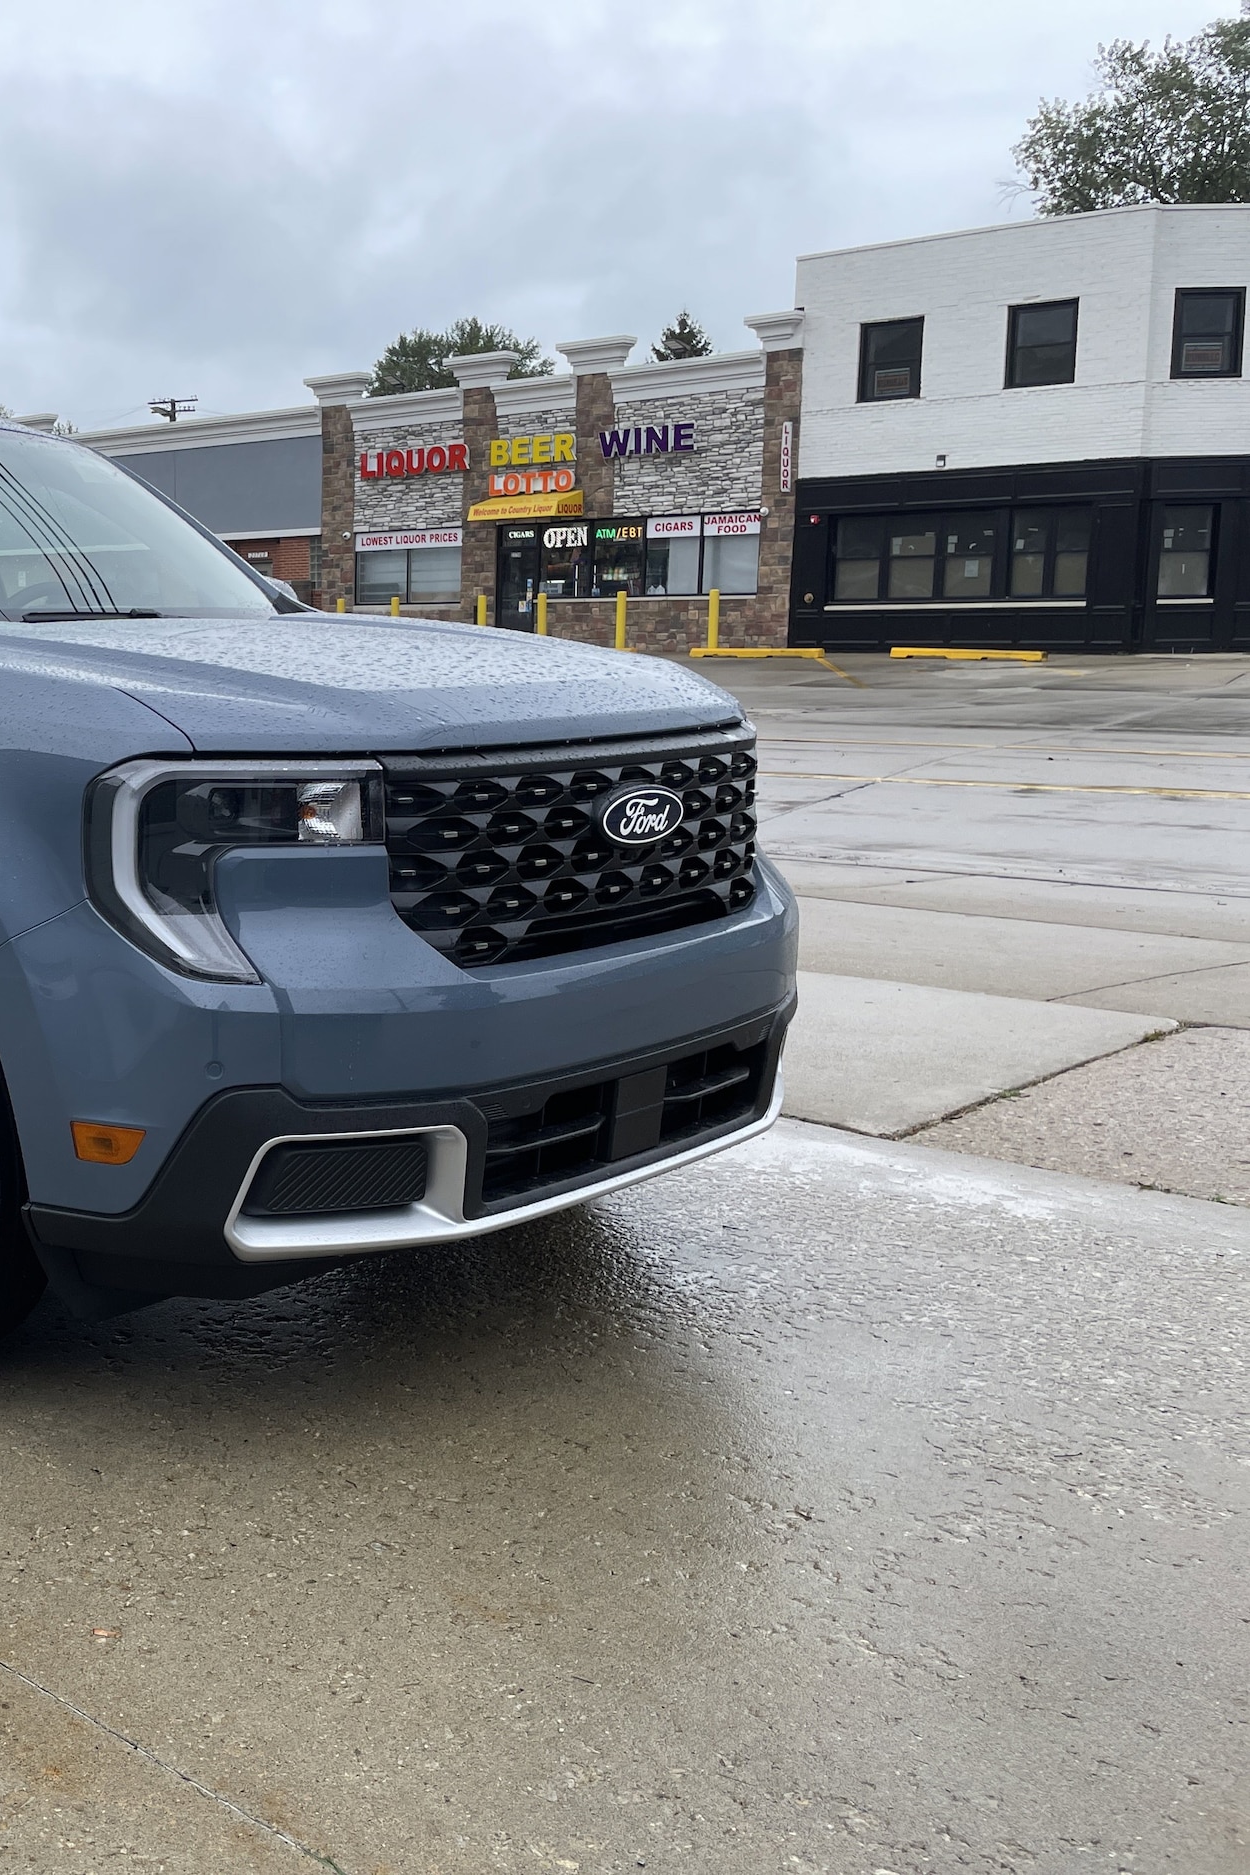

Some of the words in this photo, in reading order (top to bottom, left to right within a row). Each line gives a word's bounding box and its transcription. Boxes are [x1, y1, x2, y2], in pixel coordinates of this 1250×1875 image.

[490, 433, 577, 467] BEER
[599, 423, 695, 458] WINE
[360, 443, 470, 479] LIQUOR
[782, 425, 790, 489] LIQUOR
[488, 469, 575, 497] LOTTO
[473, 507, 499, 516] Welcome
[500, 506, 507, 514] to
[508, 506, 532, 515] Country
[533, 504, 553, 514] Liquor
[557, 504, 582, 514] LIQUOR
[655, 521, 694, 532] CIGARS
[704, 514, 762, 526] JAMAICAN
[717, 525, 747, 534] FOOD
[361, 536, 393, 547] LOWEST
[395, 534, 427, 545] LIQUOR
[429, 532, 458, 544] PRICES
[508, 530, 535, 540] CIGARS
[543, 526, 589, 549] OPEN
[619, 798, 670, 836] Ford
